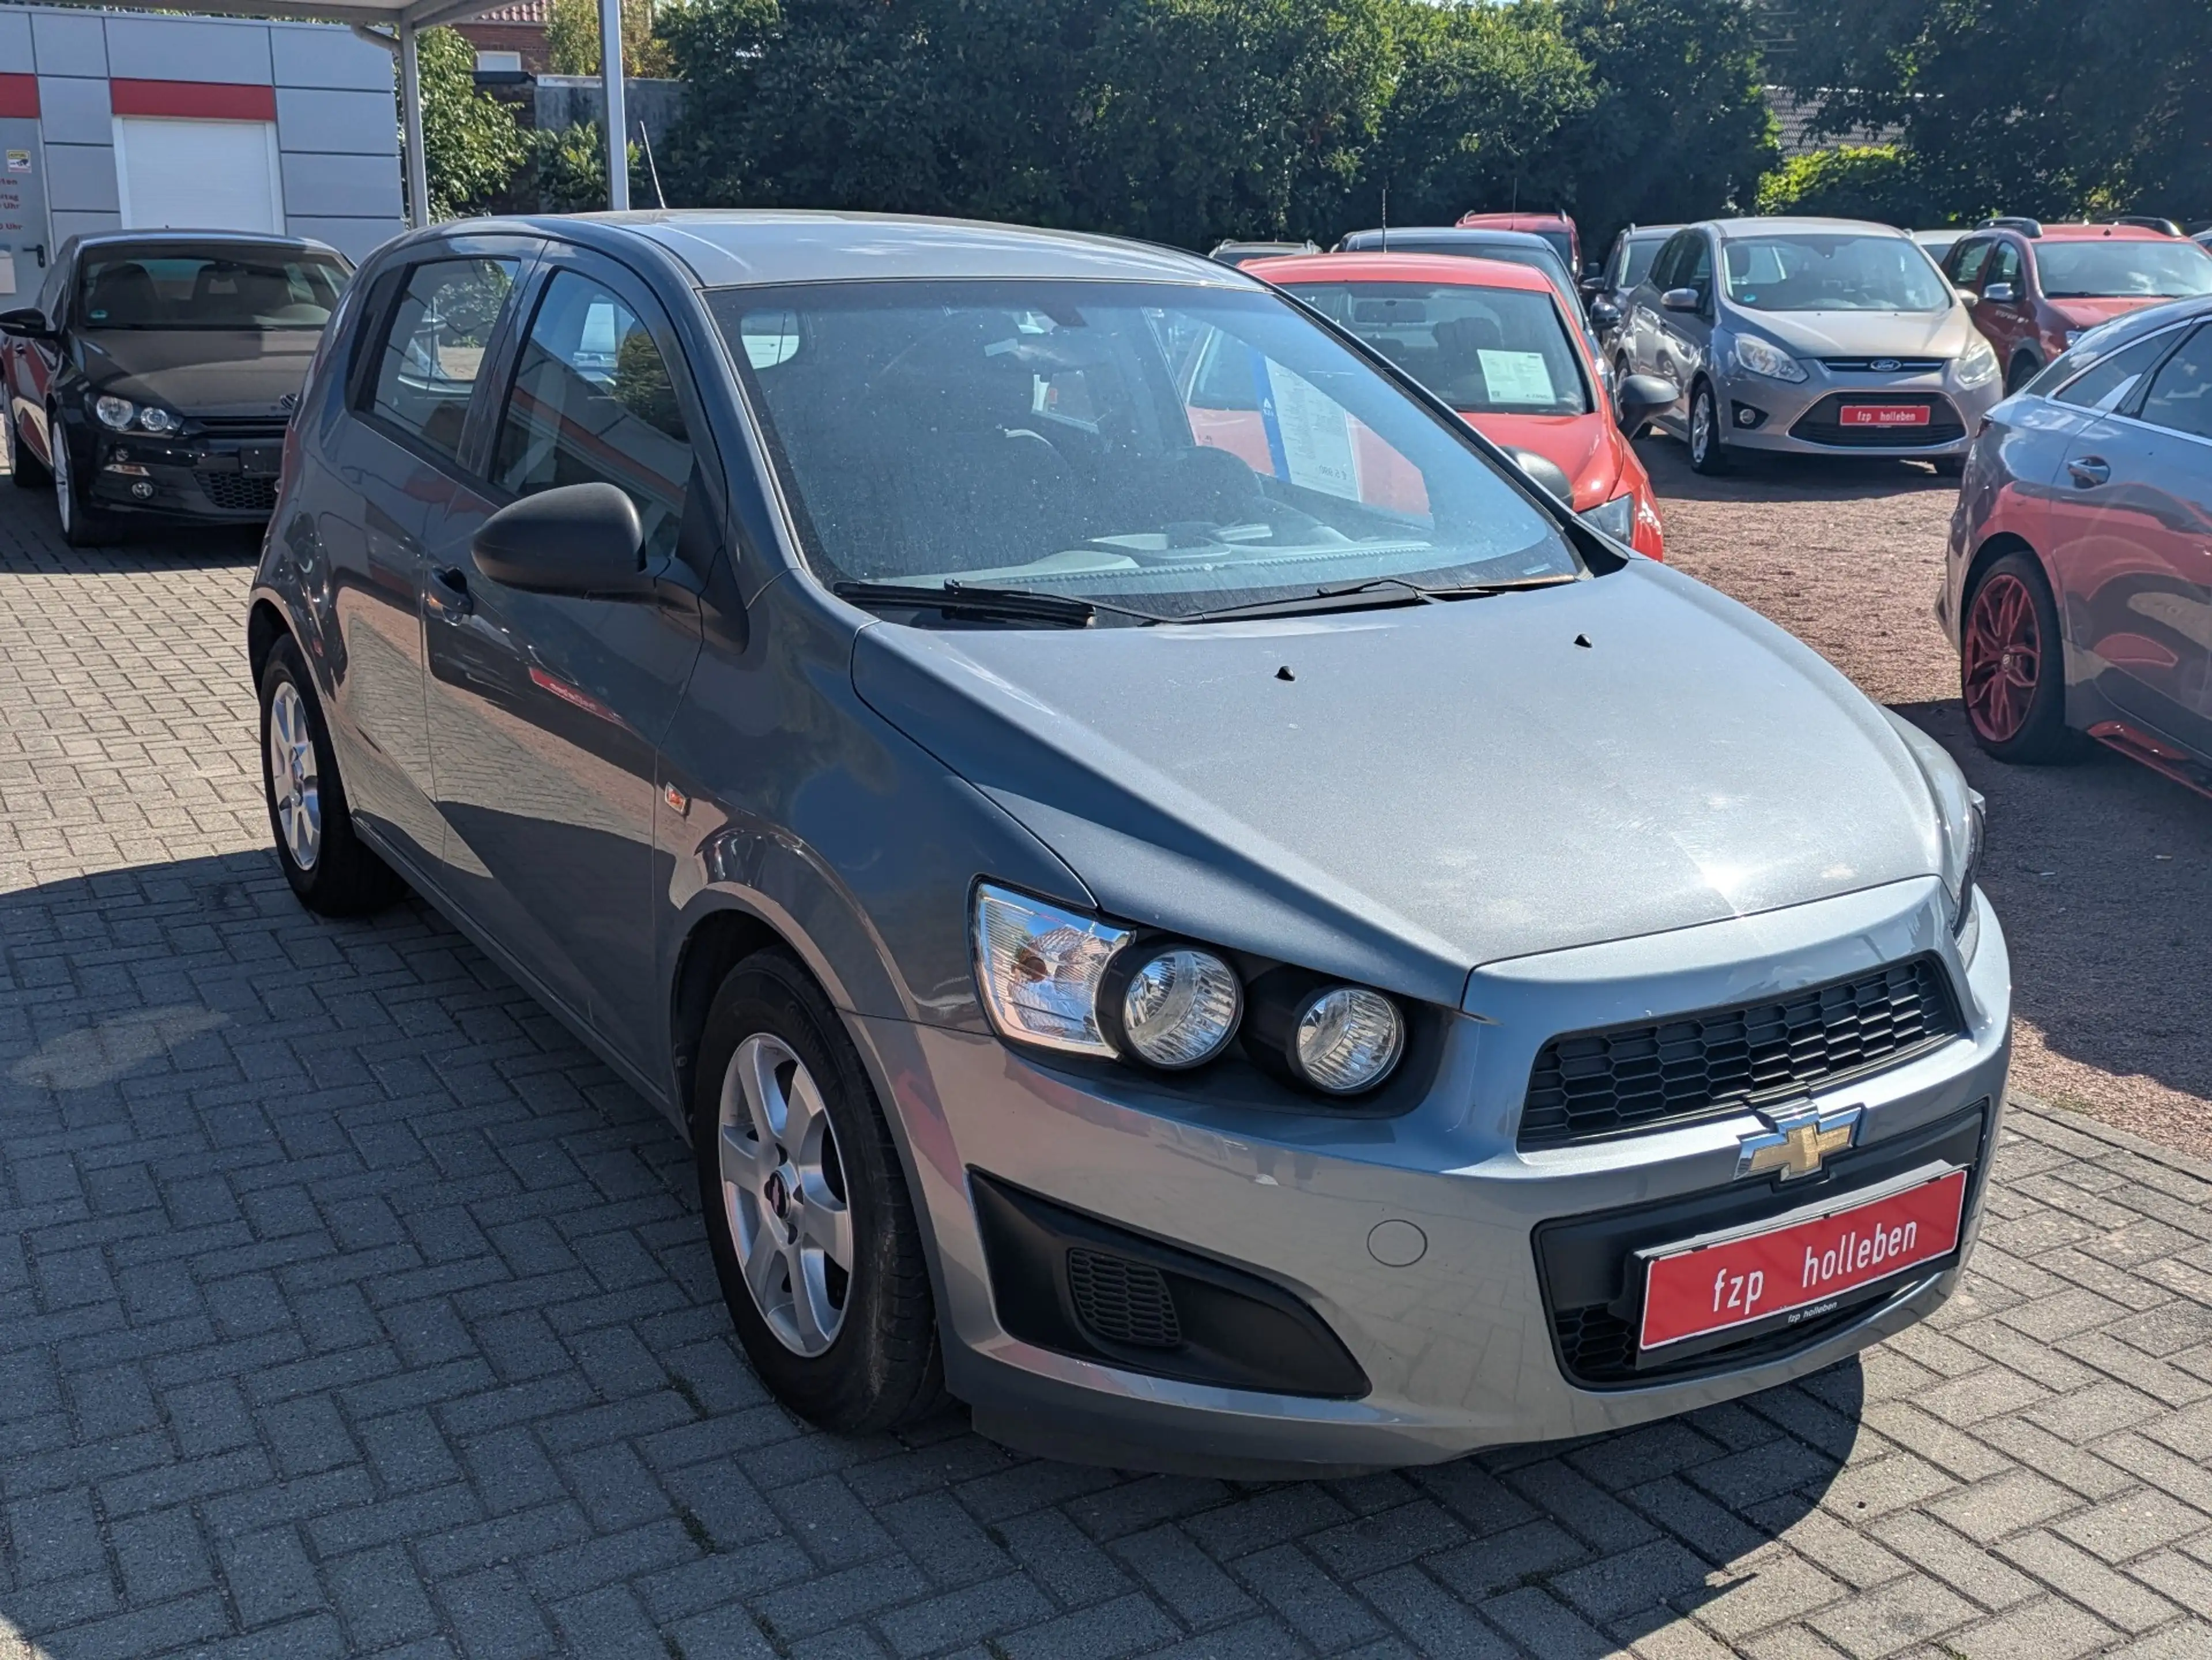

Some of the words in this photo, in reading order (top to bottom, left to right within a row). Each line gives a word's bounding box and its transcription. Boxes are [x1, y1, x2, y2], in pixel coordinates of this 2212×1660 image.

[6, 222, 24, 231] Uhr
[1857, 411, 1872, 422] fzp
[1879, 410, 1916, 421] holleben
[1713, 1268, 1764, 1315] fzp
[1802, 1220, 1917, 1288] holleben
[1787, 1312, 1801, 1324] fzp
[1803, 1301, 1838, 1318] holleben
